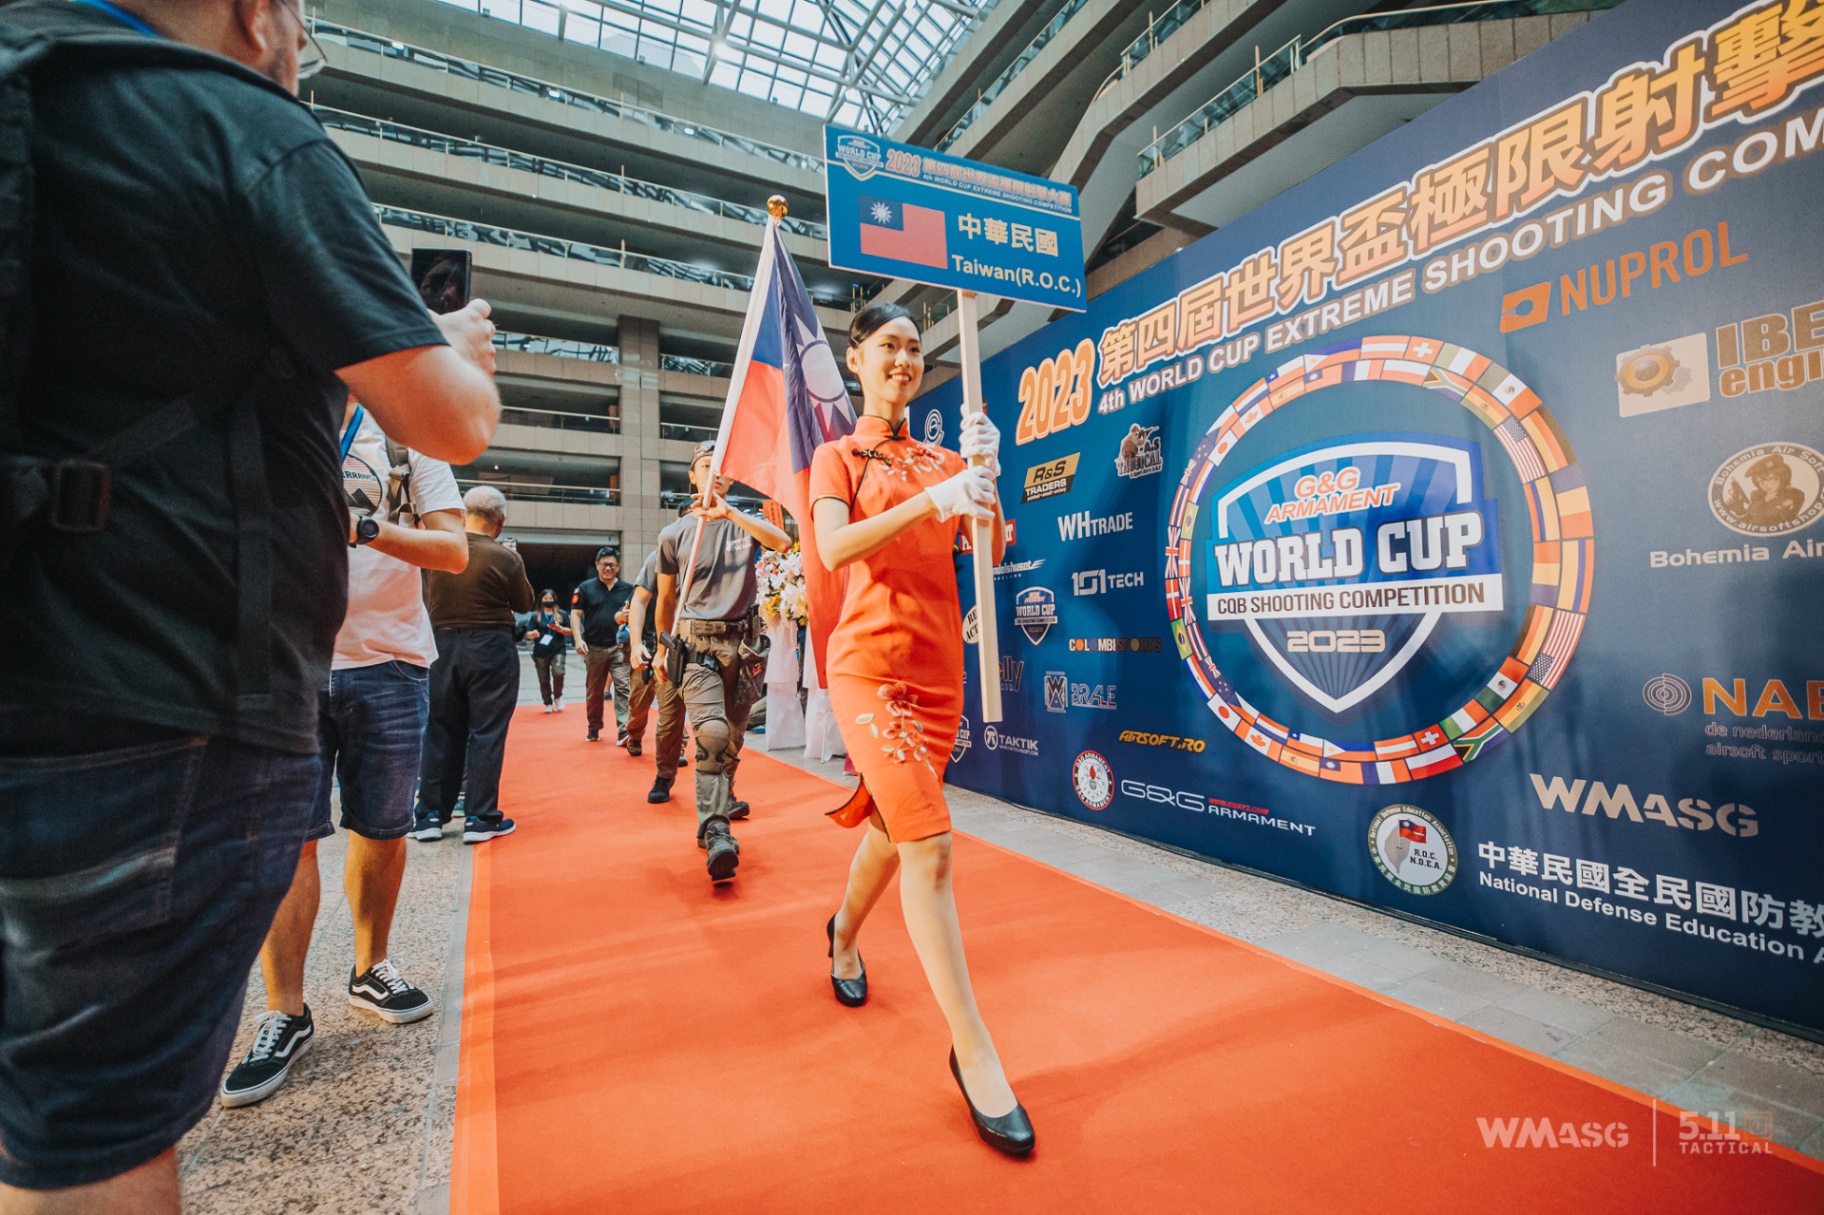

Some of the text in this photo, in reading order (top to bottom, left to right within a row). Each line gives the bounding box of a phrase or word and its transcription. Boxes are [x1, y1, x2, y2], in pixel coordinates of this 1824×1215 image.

[838, 144, 865, 158] WORLD
[866, 151, 881, 161] CUP
[885, 148, 922, 177] 2023
[934, 176, 958, 187] WORLD
[958, 182, 972, 190] CUP
[973, 185, 1001, 197] EXTREME
[1002, 192, 1033, 205] SHOOTING
[1033, 200, 1073, 214] COMPETITION
[958, 213, 1059, 257] 中華民國
[952, 254, 1082, 298] Taiwan(R.O.C.)
[1098, 106, 1824, 414] 4th WORLD CUP EXTREME SHOOTING COM
[1560, 221, 1749, 316] NUPROL
[1015, 337, 1096, 445] 2023
[1033, 460, 1067, 483] R&S
[1714, 448, 1765, 486] Bohemia
[1771, 445, 1795, 454] Air
[1025, 478, 1067, 496] TRADERS
[1295, 467, 1360, 499] G&G
[1265, 482, 1401, 524] ARMAMENT
[1214, 510, 1483, 587] WORLD CUP
[1650, 543, 1770, 568] Bohemia
[1108, 572, 1144, 589] TECH
[1016, 603, 1055, 617] WORLD CUP
[1217, 582, 1485, 615] CQB SHOOTING COMPETITION
[1286, 629, 1386, 653] 2023
[999, 734, 1038, 751] TAKTIK
[1118, 729, 1207, 754] AIRSOFT.RO
[1705, 722, 1728, 737] de
[1706, 742, 1767, 760] airsoft
[1121, 779, 1204, 812] G&G
[1529, 773, 1759, 837] WMASG
[1208, 804, 1316, 836] ARMAMENT
[1402, 805, 1432, 822] Education
[1431, 820, 1454, 855] Association
[1409, 856, 1443, 871] N.D.E.A.
[1414, 848, 1438, 861] R.O.C.
[1479, 871, 1558, 903] National
[1565, 891, 1658, 926] Defense
[1665, 912, 1804, 961] Education
